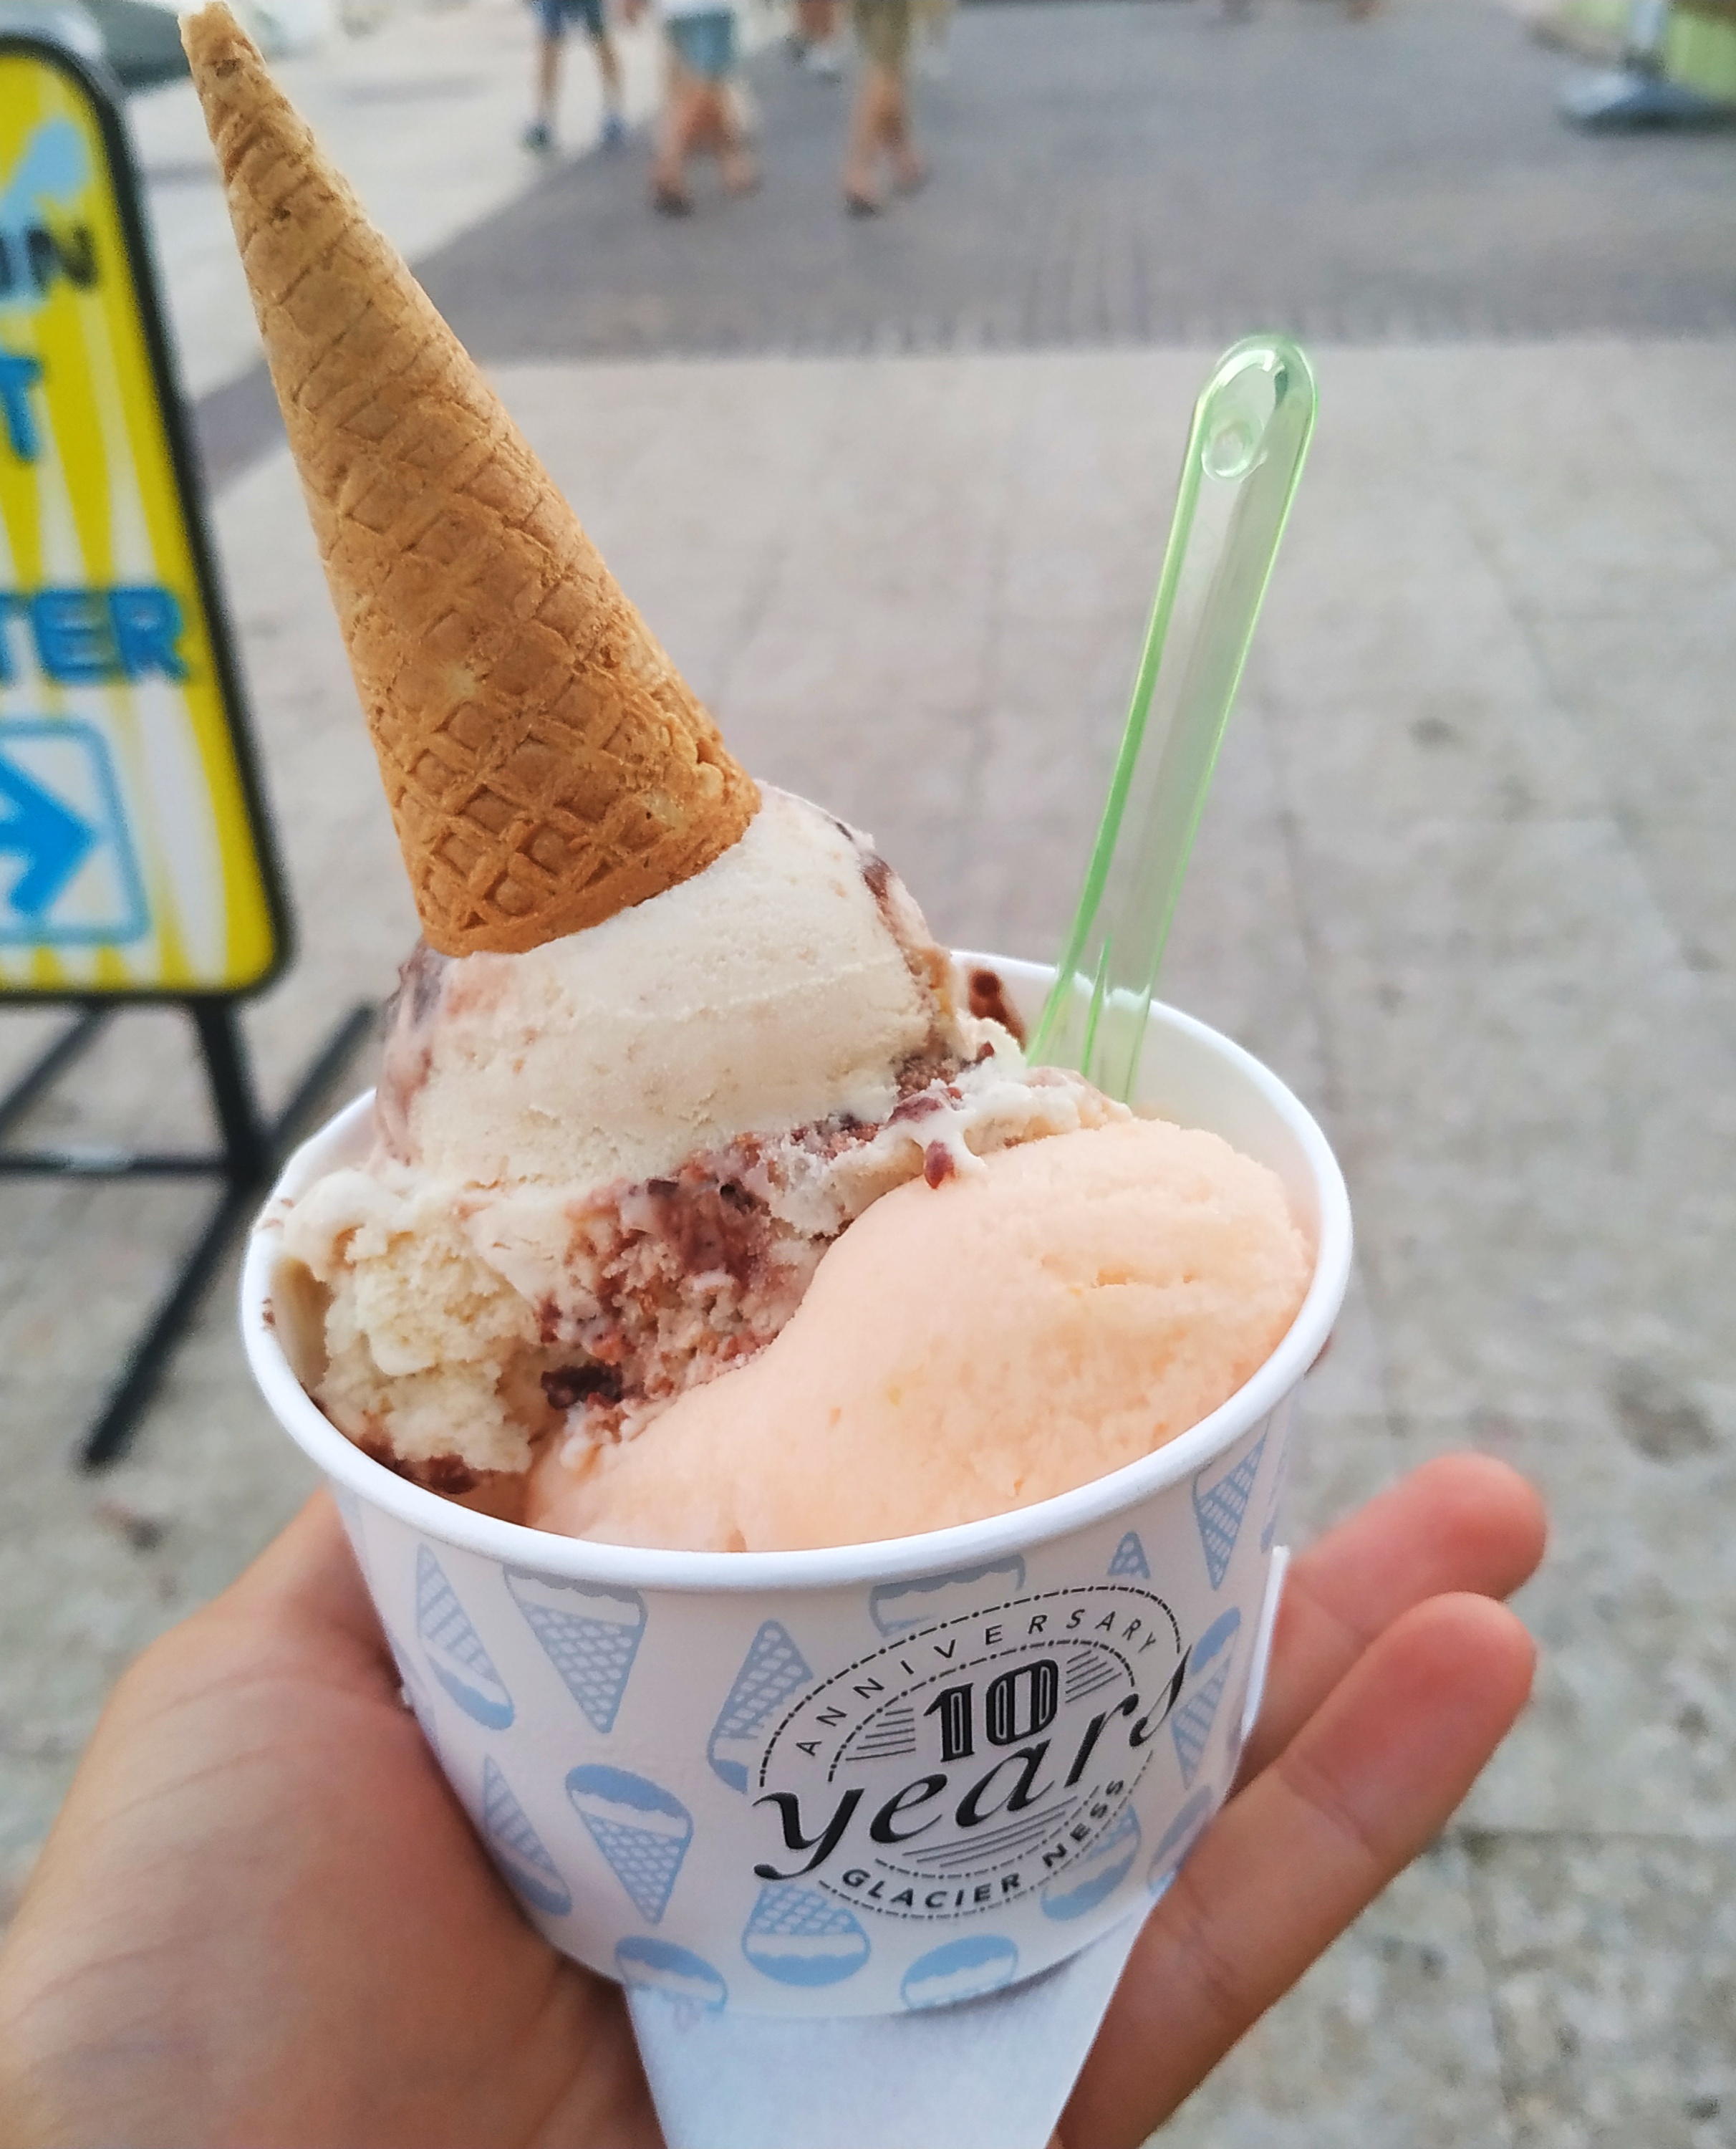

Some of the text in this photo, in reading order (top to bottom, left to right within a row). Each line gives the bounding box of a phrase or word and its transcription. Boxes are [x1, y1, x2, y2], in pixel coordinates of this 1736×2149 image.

[796, 1608, 1156, 1756] ANNIVERSARY
[923, 1659, 1059, 1762] 10
[752, 1643, 1192, 1880] years
[842, 1779, 1124, 1908] GLACIER NESS
